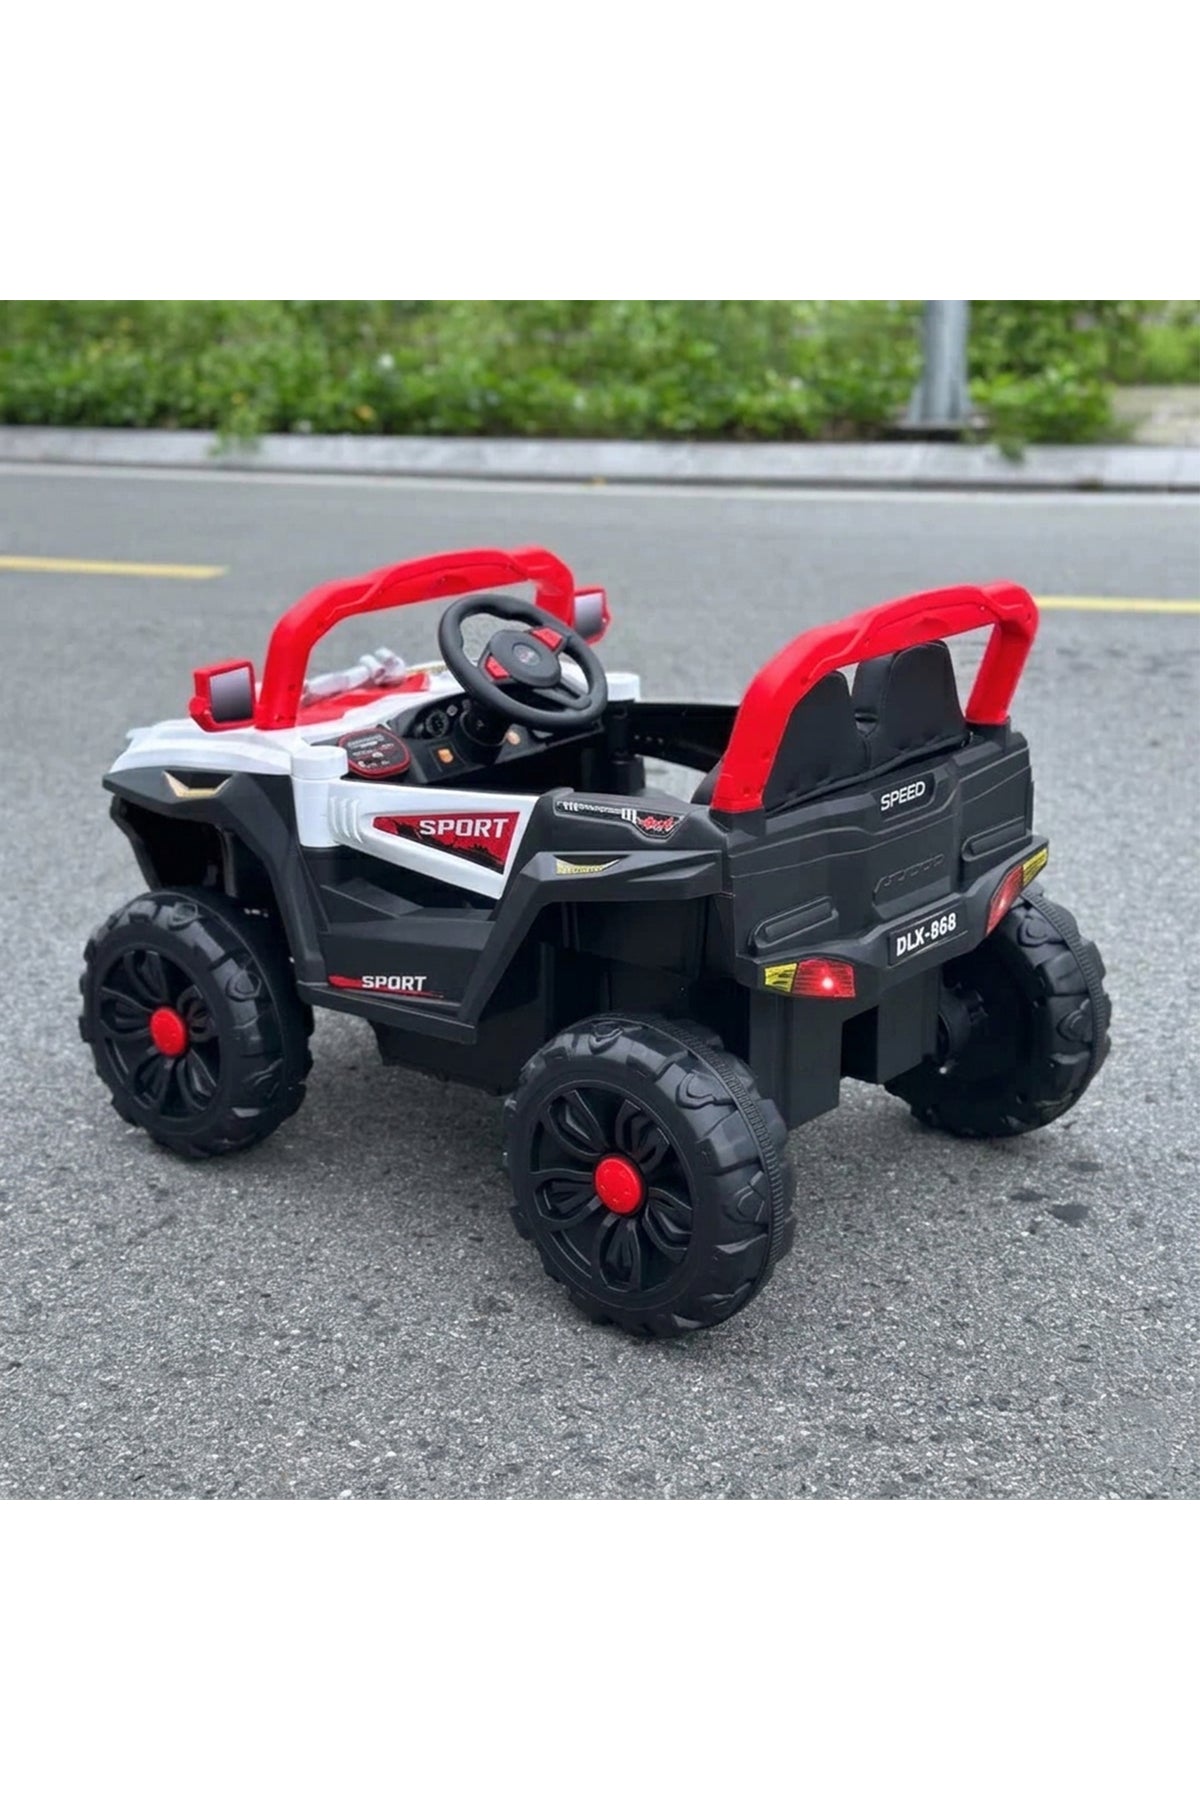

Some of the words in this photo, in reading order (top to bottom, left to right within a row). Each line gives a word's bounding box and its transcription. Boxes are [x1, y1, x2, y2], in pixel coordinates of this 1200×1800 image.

[880, 781, 926, 811] SPEED
[419, 818, 510, 839] SPORT
[896, 912, 957, 957] DLX-868
[361, 975, 427, 992] SPORT
